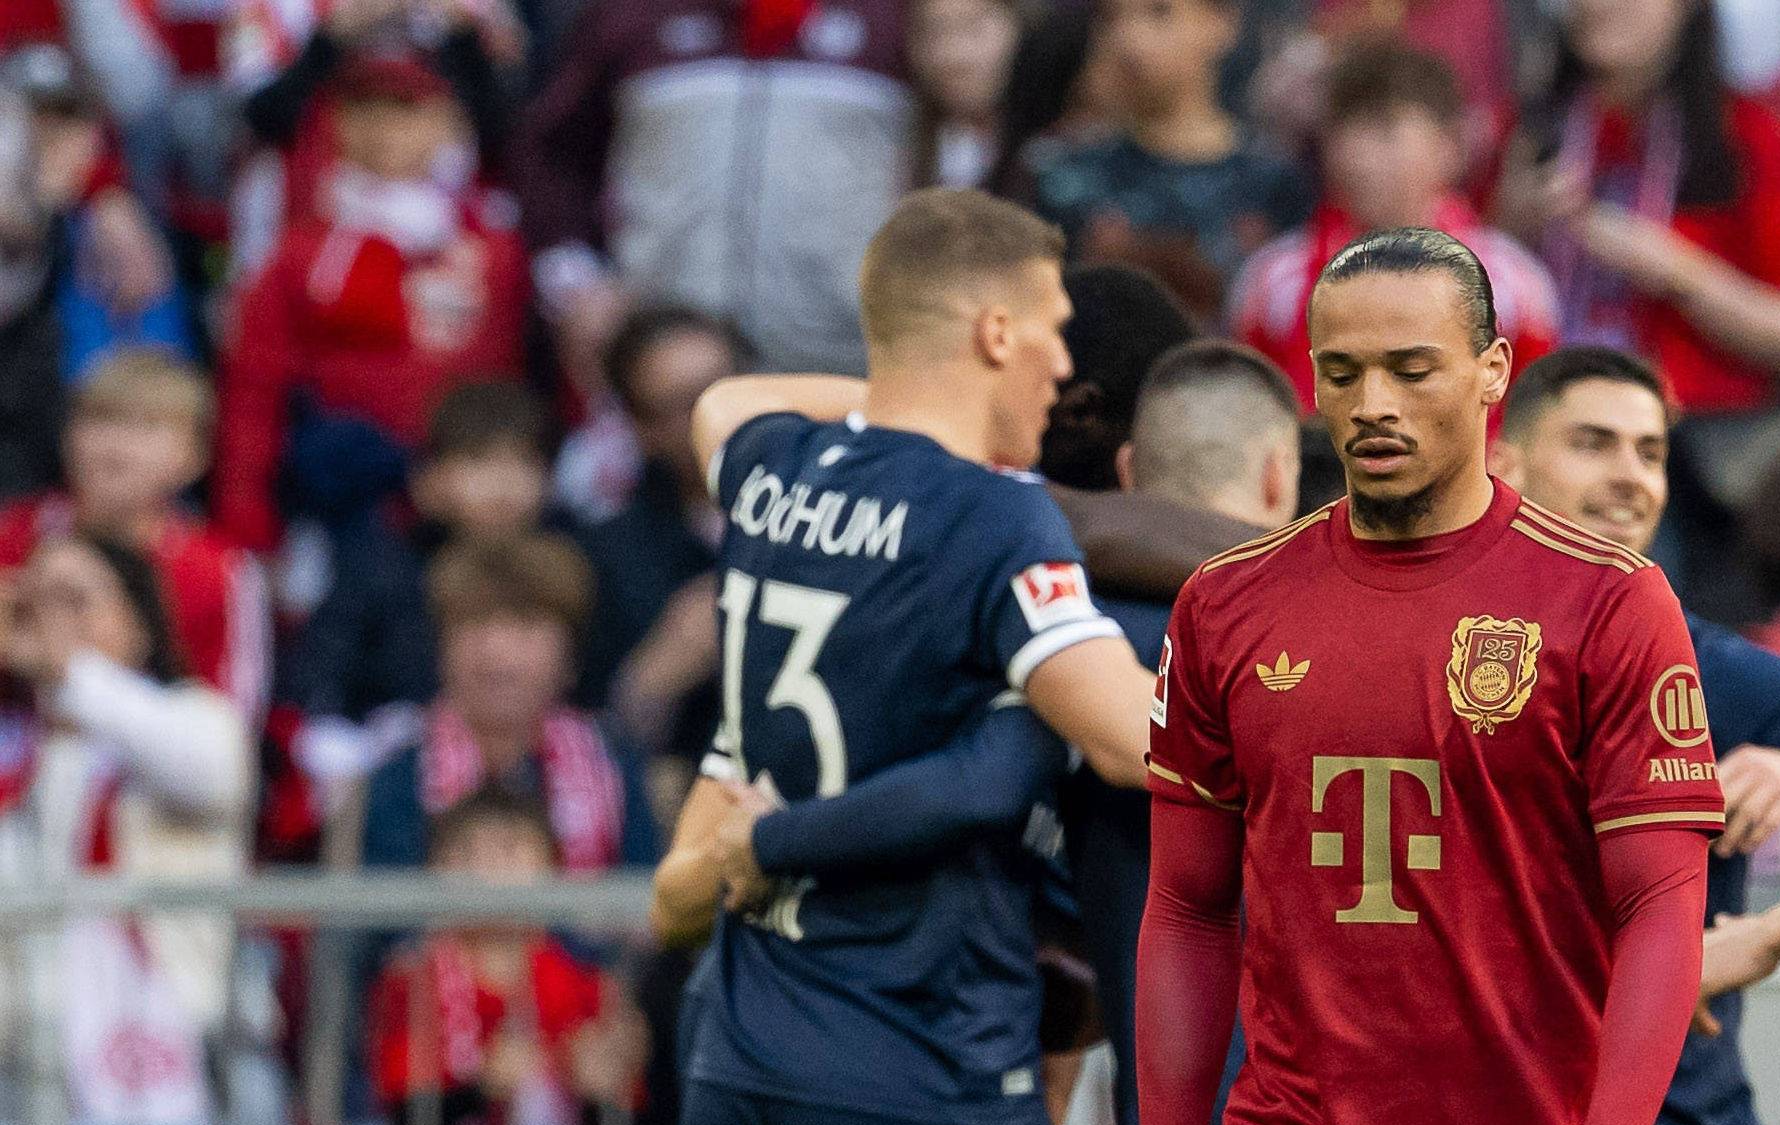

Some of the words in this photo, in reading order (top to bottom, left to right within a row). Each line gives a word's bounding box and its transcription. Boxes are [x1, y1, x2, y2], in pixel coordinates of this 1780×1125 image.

[713, 567, 852, 808] 13
[1476, 638, 1519, 661] 125
[1311, 757, 1441, 924] T
